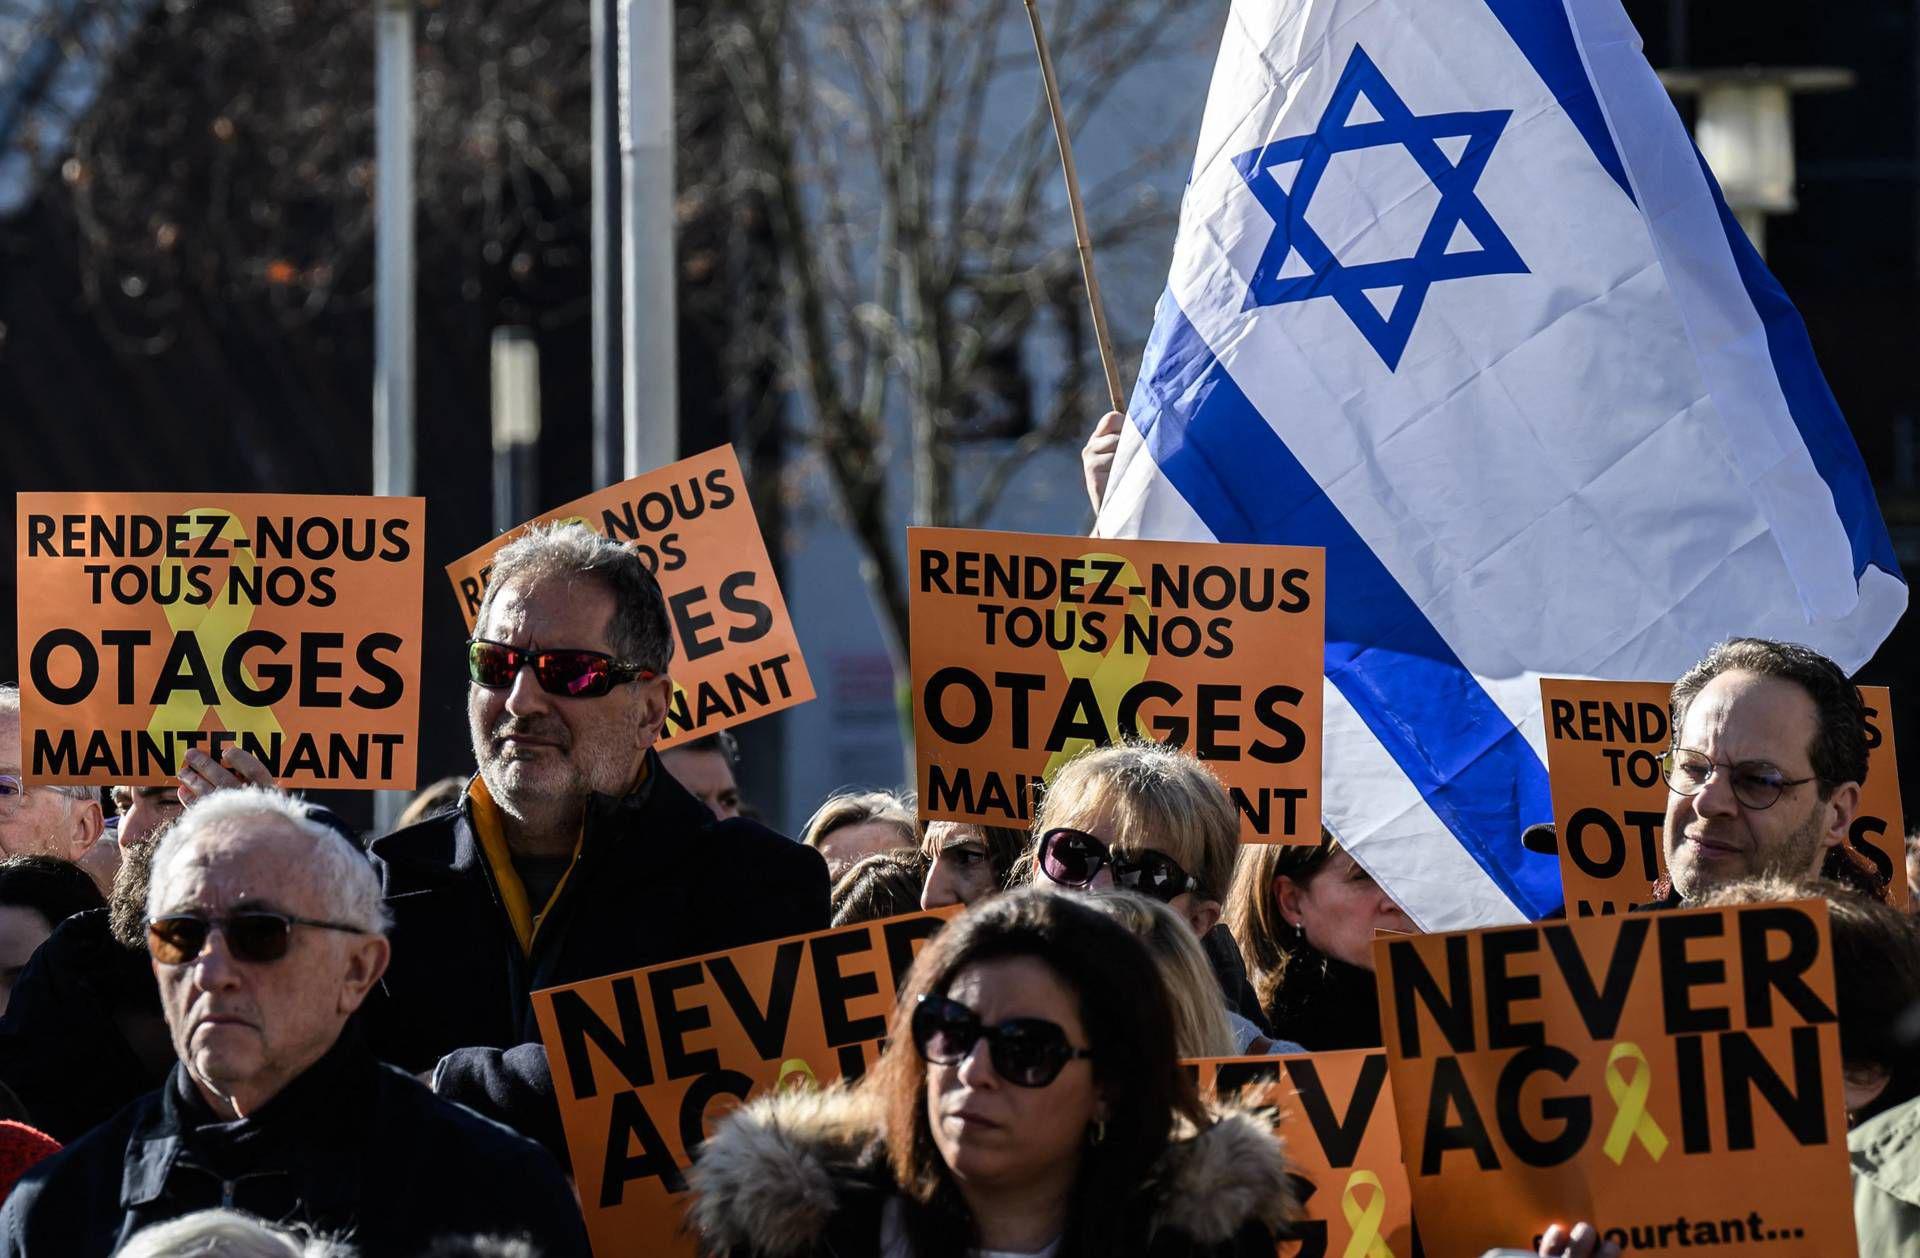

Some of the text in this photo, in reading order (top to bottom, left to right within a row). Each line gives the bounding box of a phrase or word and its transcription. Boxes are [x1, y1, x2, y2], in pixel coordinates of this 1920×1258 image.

[28, 514, 410, 563] RENDEZ-NOUS
[84, 564, 336, 608] TOUS NOS
[920, 548, 1311, 614] RENDEZ-NOUS
[977, 603, 1234, 659] TOUS NOS
[29, 628, 405, 710] OTAGES
[923, 666, 1307, 764] OTAGES
[1388, 907, 1838, 1060] NEVER
[1595, 1211, 1805, 1251] ourtant...
